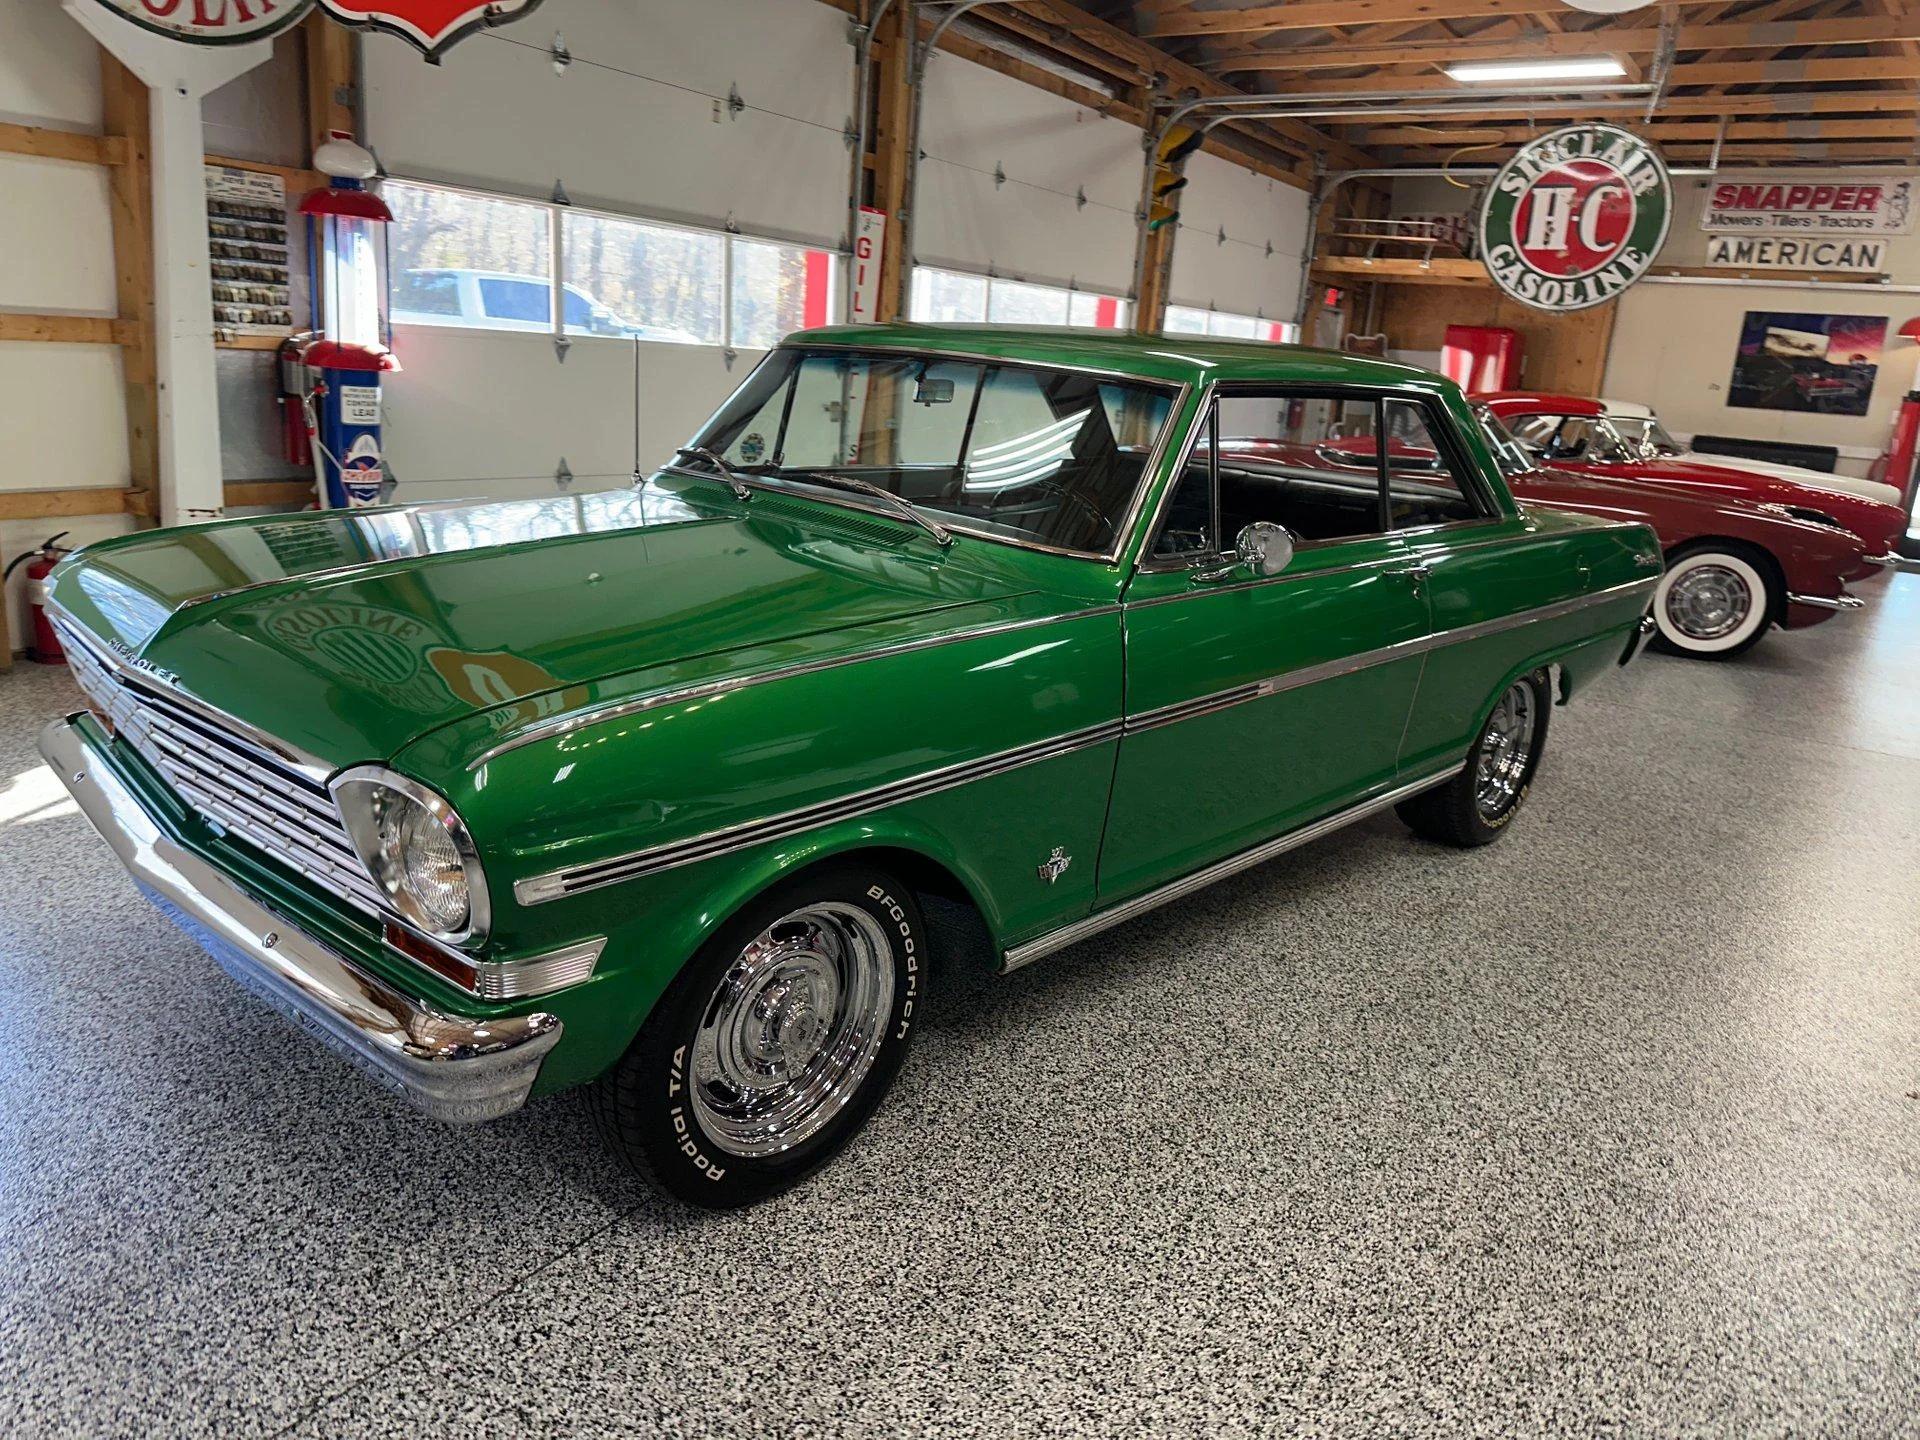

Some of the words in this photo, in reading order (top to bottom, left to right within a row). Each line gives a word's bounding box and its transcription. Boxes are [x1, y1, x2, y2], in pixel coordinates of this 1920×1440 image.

[1500, 132, 1660, 198] SINCLAIR
[1709, 213, 1764, 226] Mowers
[1771, 214, 1812, 227] Tillers
[1818, 214, 1875, 229] Tractors
[1712, 184, 1884, 211] SNAPPER
[853, 236, 873, 322] GIL
[1489, 244, 1650, 306] GASOLINE
[1713, 240, 1880, 268] AMERICAN
[669, 1044, 687, 1098] T/A
